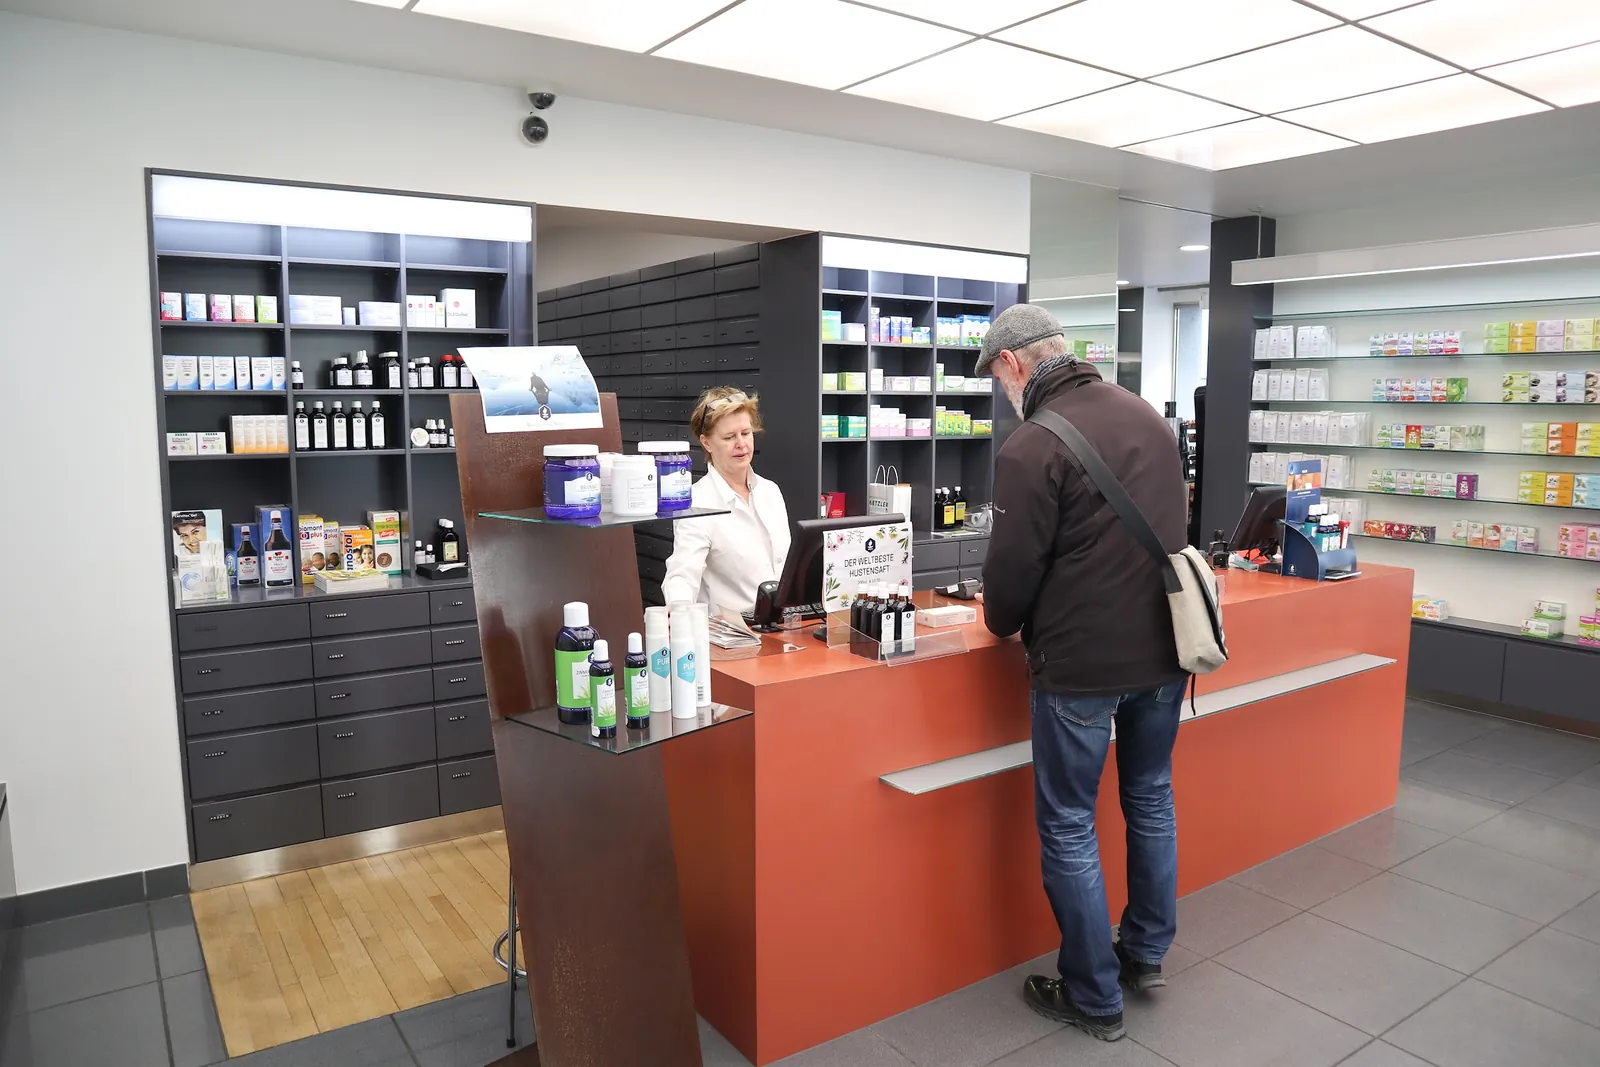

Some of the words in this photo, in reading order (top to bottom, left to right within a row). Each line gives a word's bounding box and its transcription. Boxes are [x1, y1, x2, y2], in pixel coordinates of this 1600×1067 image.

[344, 534, 354, 571] nostol
[844, 558, 857, 568] DER
[858, 554, 894, 566] WELTBESTE
[849, 564, 891, 578] HUSTENSAFT
